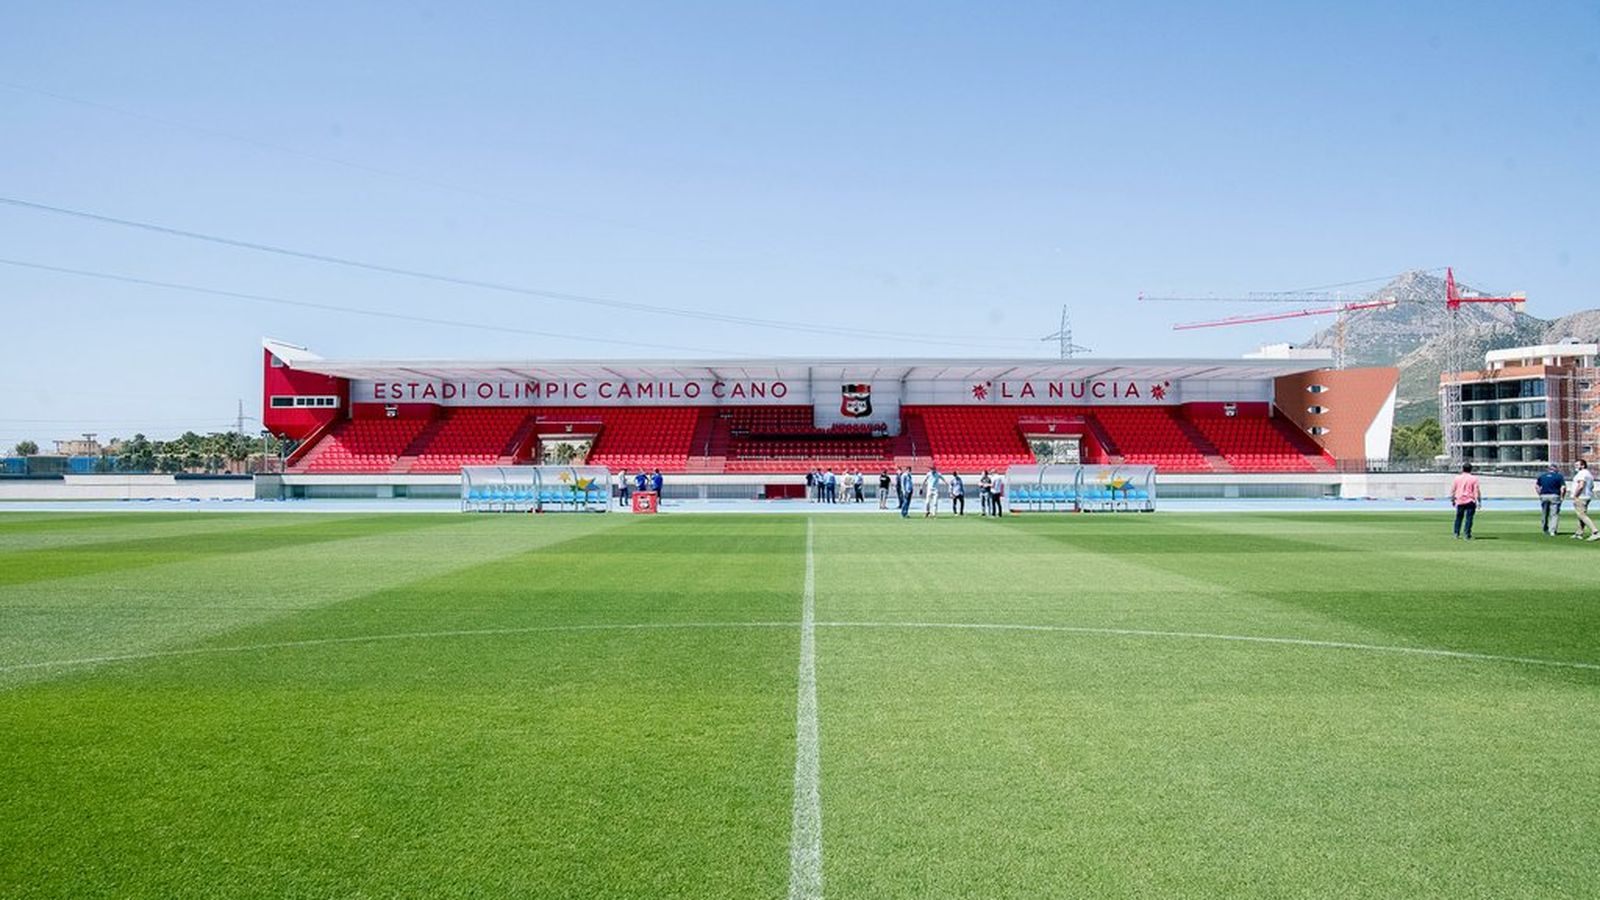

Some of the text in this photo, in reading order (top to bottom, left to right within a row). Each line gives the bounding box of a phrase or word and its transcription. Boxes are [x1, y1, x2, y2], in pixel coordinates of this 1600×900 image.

[374, 382, 787, 399] ESTADI OLIMPIC CAMILO CANO
[1002, 382, 1140, 398] LA NUCIA
